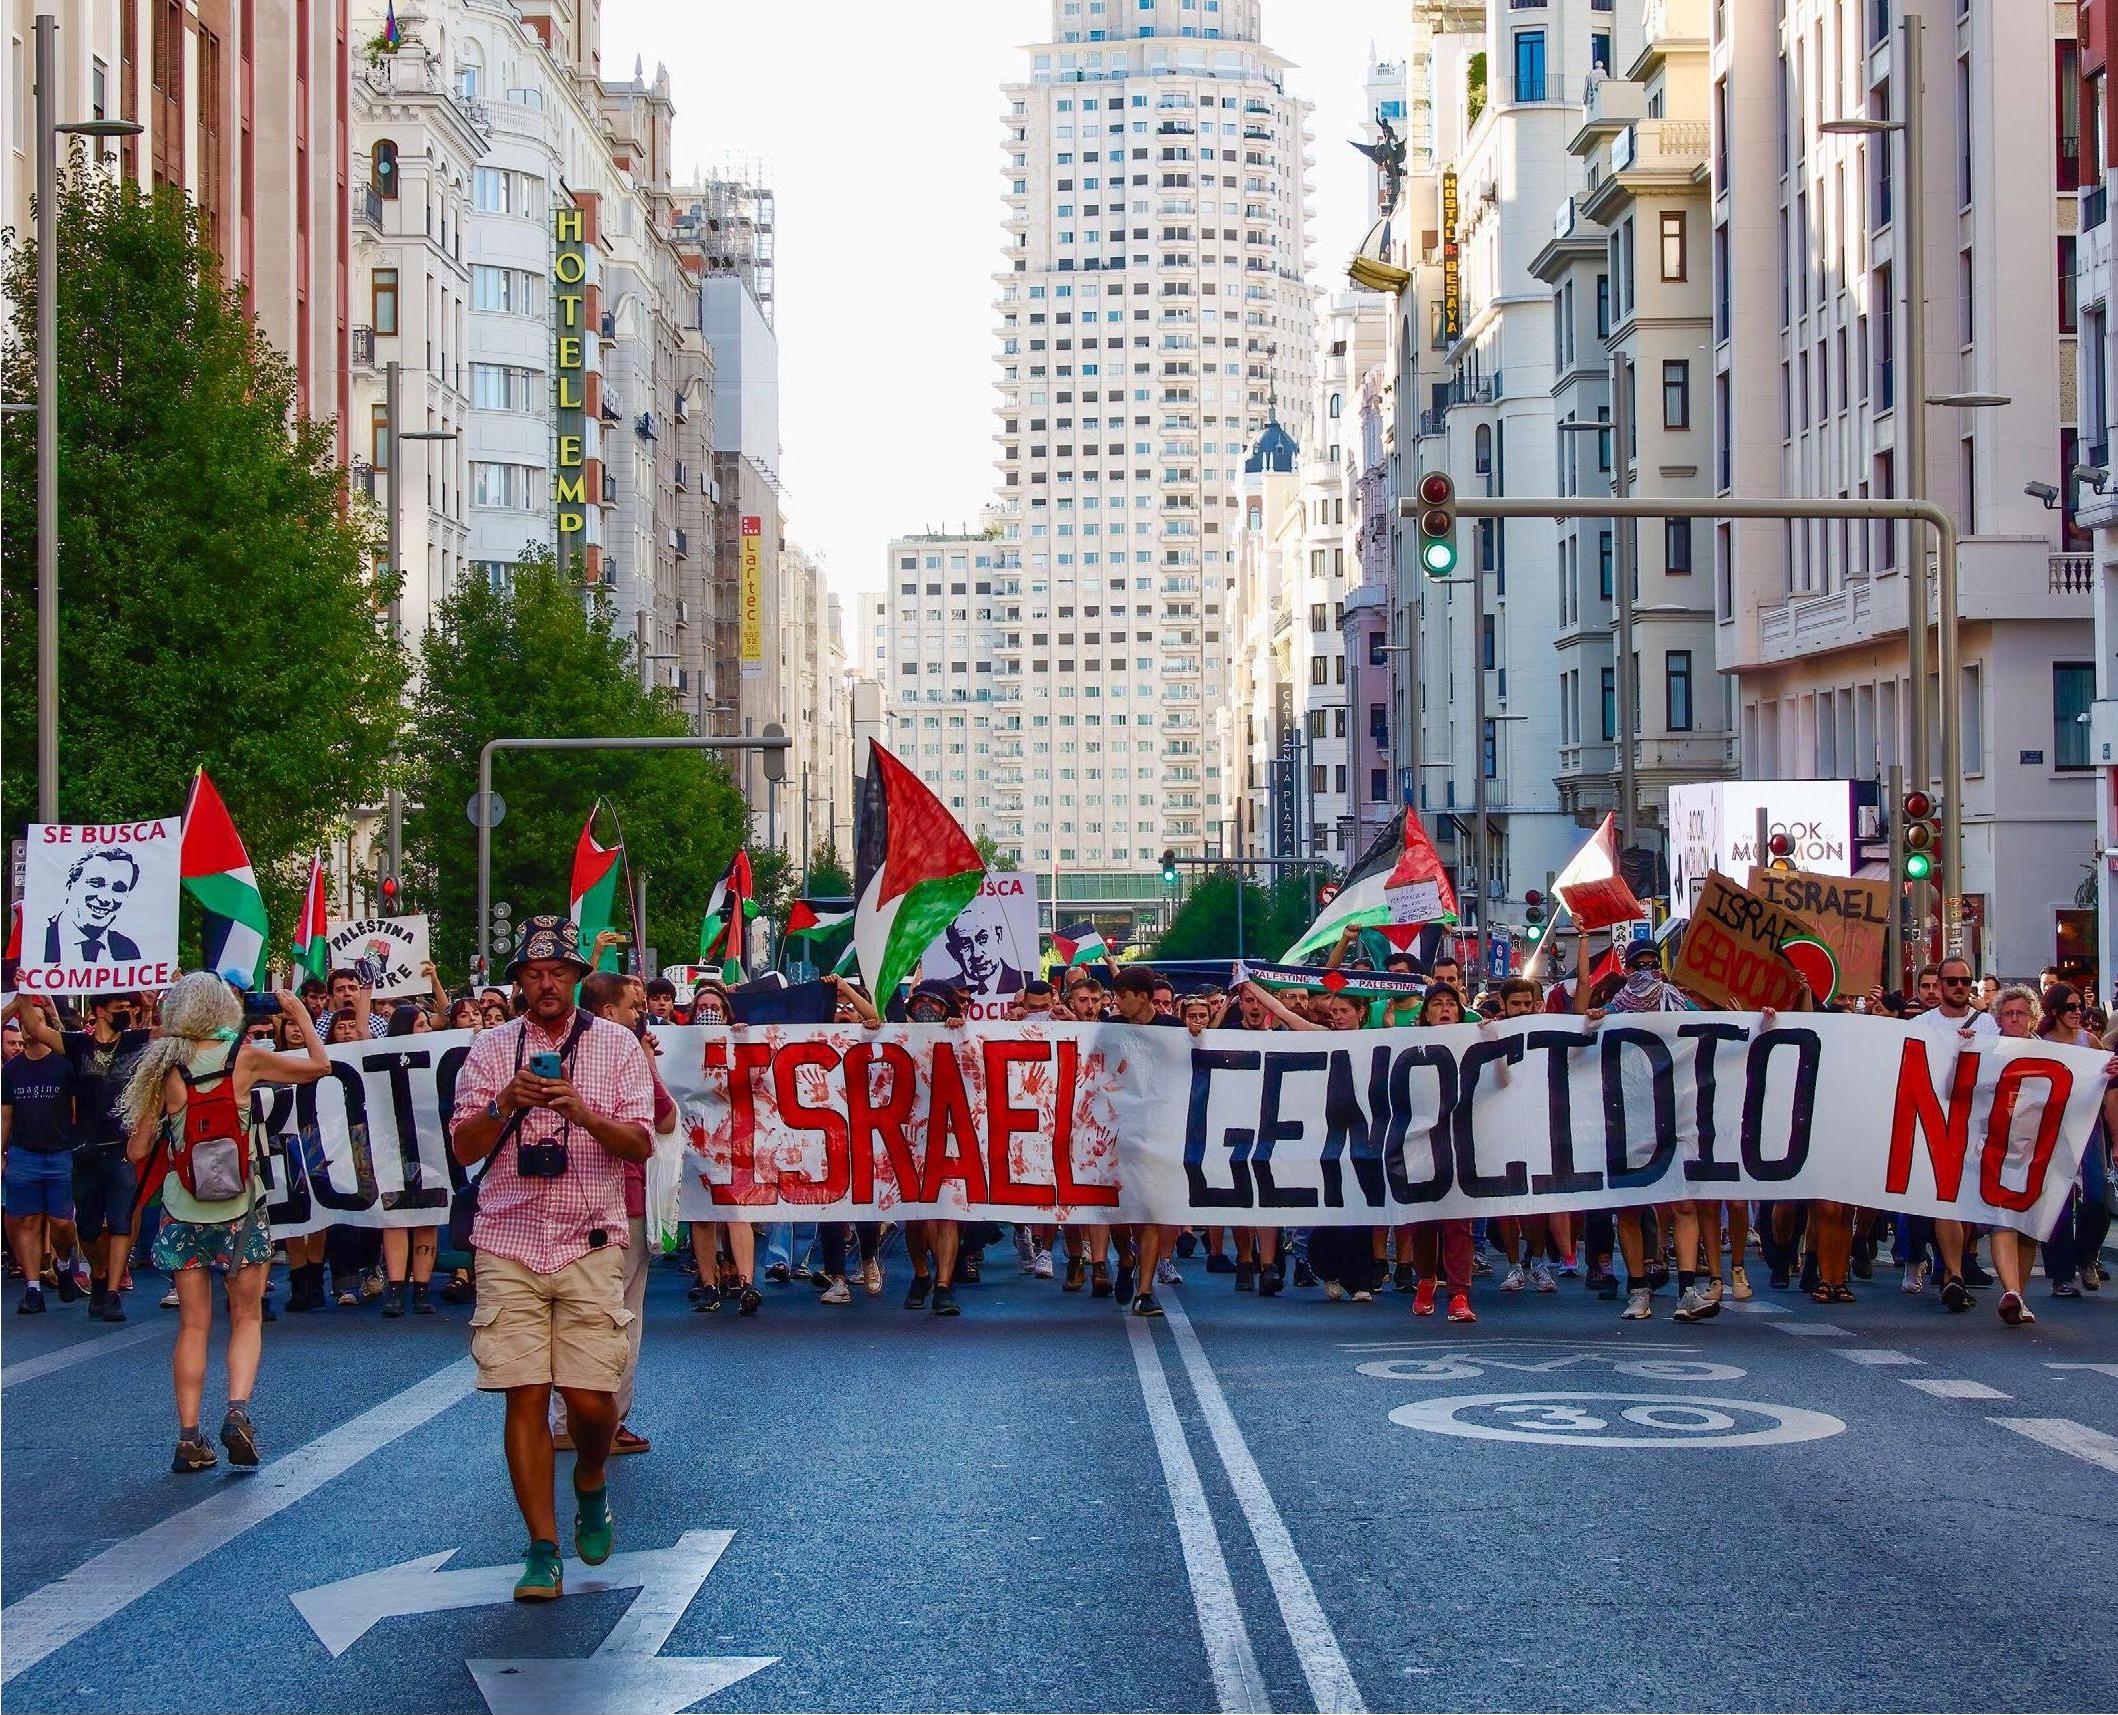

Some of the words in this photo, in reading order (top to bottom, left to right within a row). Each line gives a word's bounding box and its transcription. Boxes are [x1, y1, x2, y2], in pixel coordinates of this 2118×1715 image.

[555, 210, 586, 408] HOTEL
[1445, 261, 1457, 333] BESAYA
[746, 538, 756, 621] Lartec
[1283, 690, 1292, 782] CATALONIA
[1283, 790, 1292, 842] PLAZA
[1769, 822, 1822, 840] OOK
[43, 825, 73, 844] SE
[81, 821, 167, 845] BUSCA
[1762, 877, 1886, 924] ISRAEL
[331, 920, 414, 951] PALESTINA
[25, 962, 169, 990] CÓMPLICE
[374, 963, 413, 989] BRE
[1252, 969, 1310, 984] PALESTINE
[1358, 980, 1418, 991] PALESTINE
[704, 1040, 1120, 1207] ISRAEL
[1183, 1023, 1822, 1208] GENOCIDIO
[1885, 1037, 2074, 1213] NO
[1494, 1404, 1735, 1431] 30
